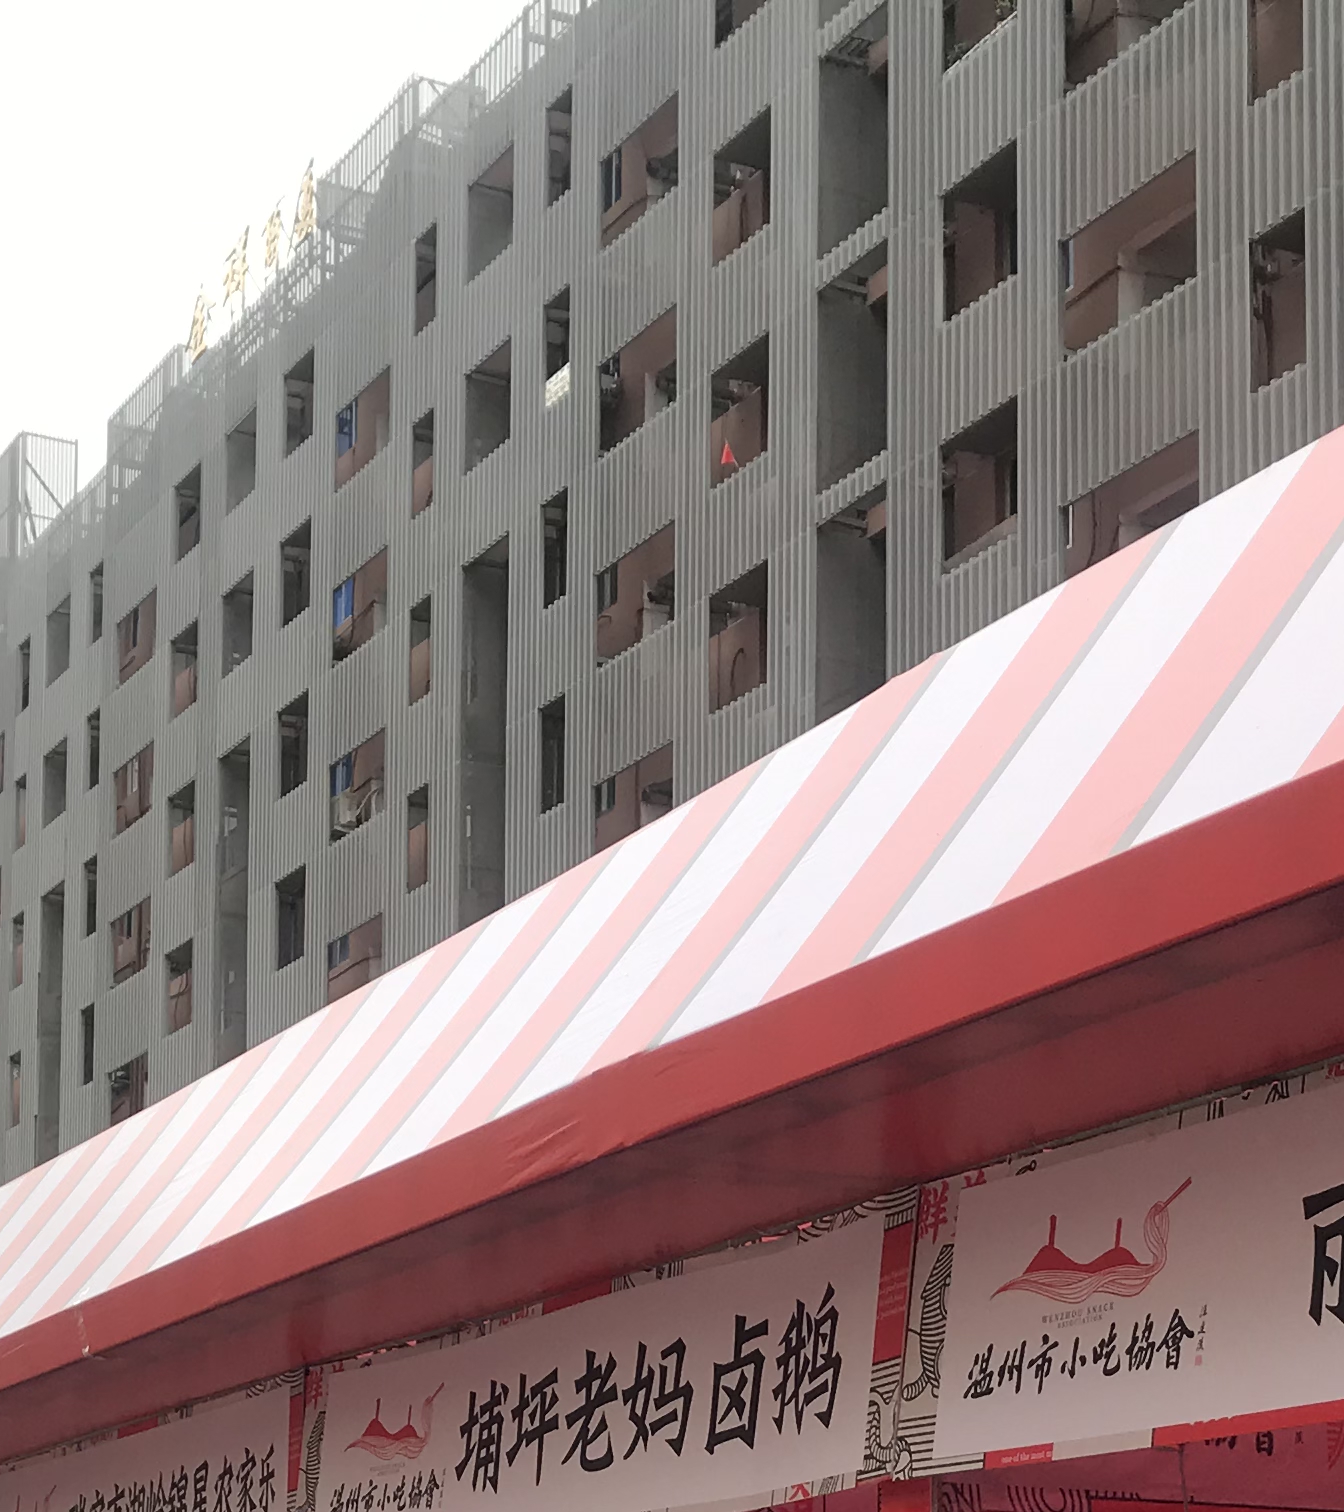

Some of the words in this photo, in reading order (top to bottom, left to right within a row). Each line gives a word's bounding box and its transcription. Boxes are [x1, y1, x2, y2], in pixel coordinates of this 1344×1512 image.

[454, 1280, 843, 1494] 埔坪老妈卤鹅
